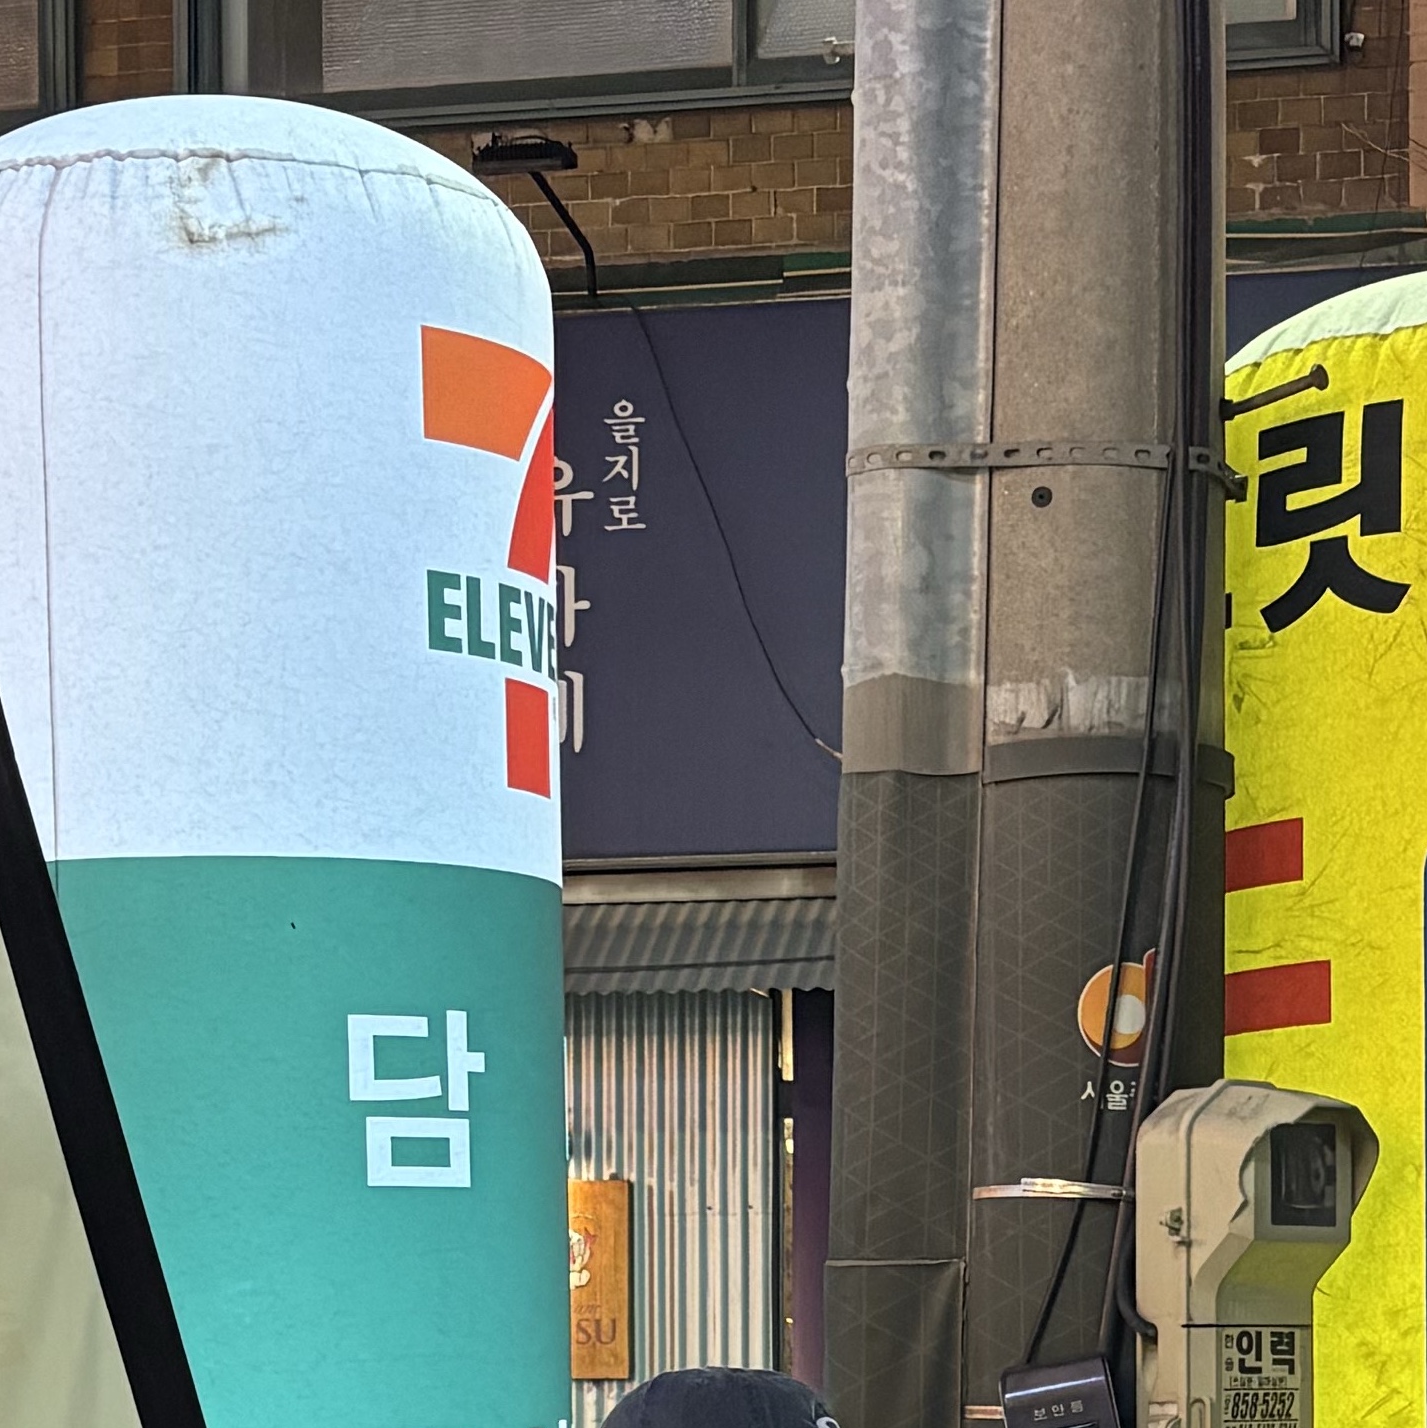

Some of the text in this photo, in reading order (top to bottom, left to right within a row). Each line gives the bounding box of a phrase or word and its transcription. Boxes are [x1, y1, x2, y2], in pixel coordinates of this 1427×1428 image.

[602, 399, 647, 532] 을지로
[1226, 398, 1412, 634] 릿
[426, 568, 556, 684] ELEVE
[347, 1009, 486, 1188] 담
[575, 1317, 618, 1346] SU
